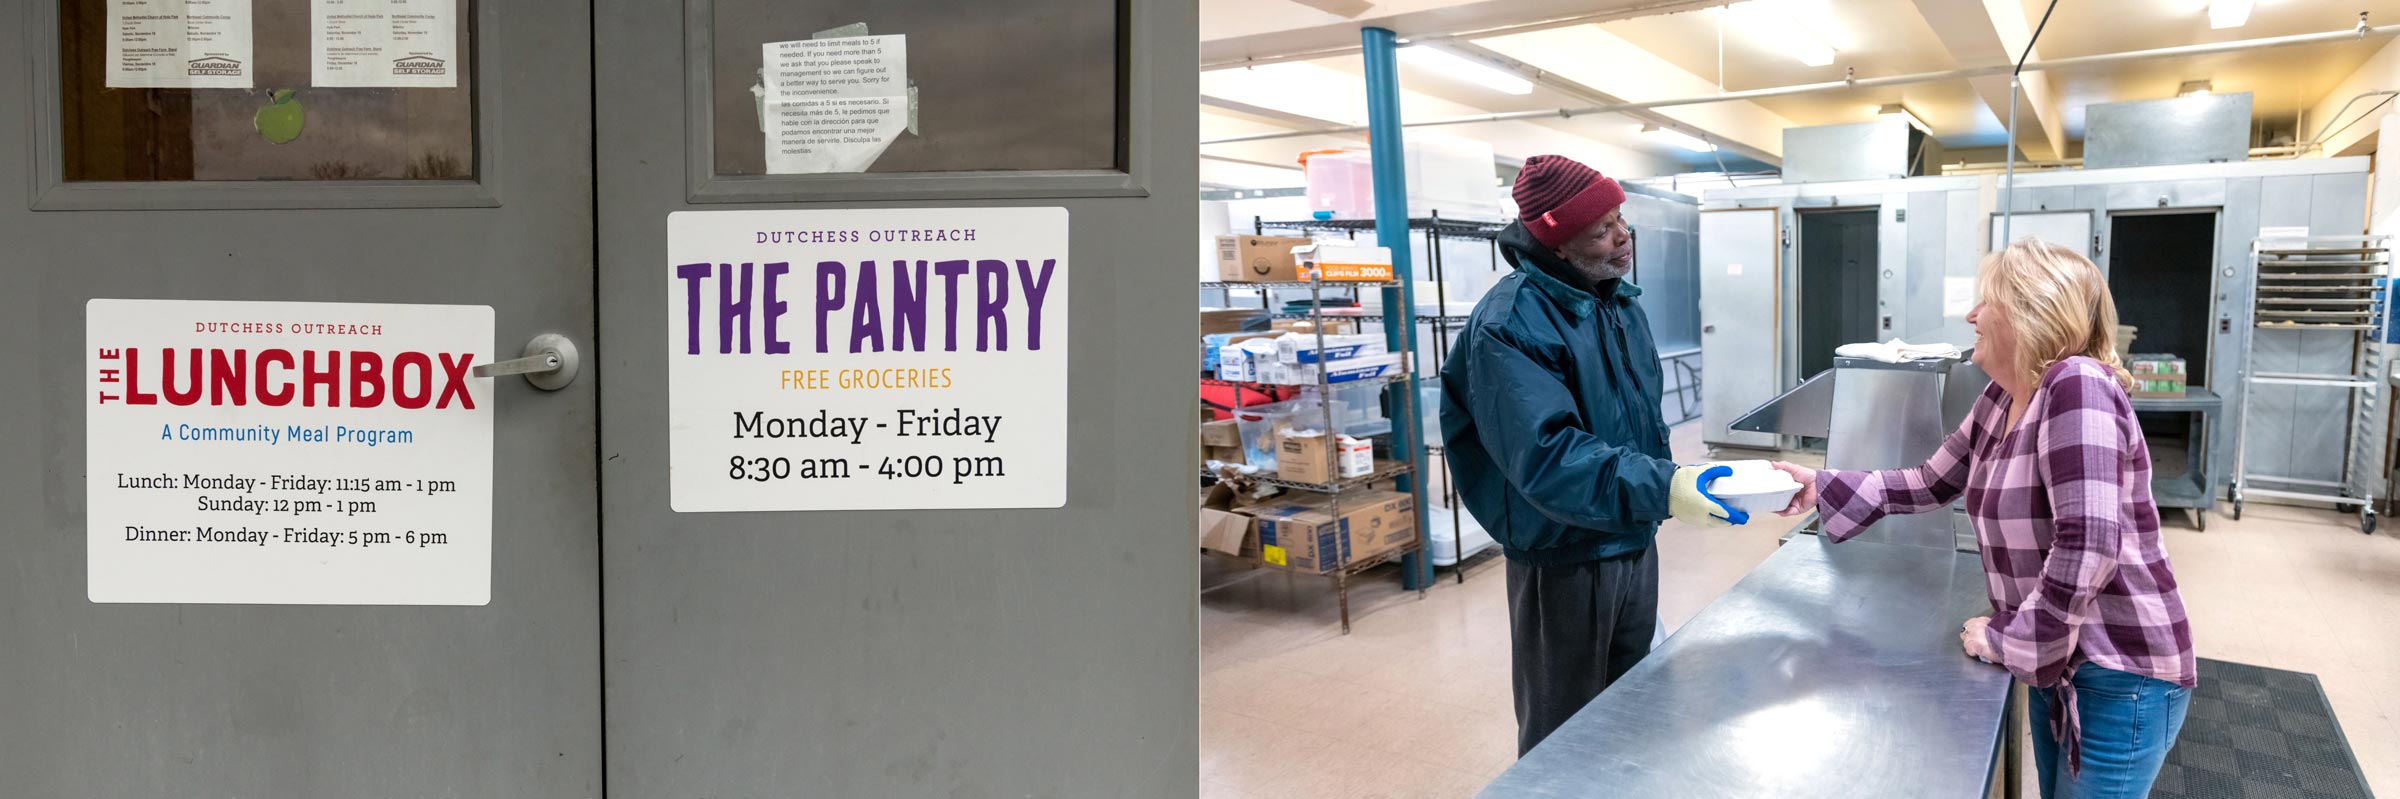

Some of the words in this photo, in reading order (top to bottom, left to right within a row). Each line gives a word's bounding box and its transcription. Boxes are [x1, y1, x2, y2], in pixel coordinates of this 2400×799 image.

[757, 231, 859, 244] DUTCHESS
[869, 229, 977, 242] OUTREACH
[1360, 266, 1386, 278] 3000
[676, 262, 791, 356] THE
[815, 258, 1057, 353] PANTRY
[195, 322, 283, 334] DUTCHESS
[291, 323, 382, 336] OUTREACH
[99, 347, 121, 405] THE
[125, 347, 477, 411] LUNCHBOX
[781, 370, 830, 390] FREE
[838, 368, 952, 389] GROCERIES
[1330, 367, 1379, 377] Aluminum
[1358, 371, 1376, 379] Foil
[161, 424, 173, 441] A
[179, 424, 281, 446] Community
[287, 425, 329, 443] Meal
[336, 426, 413, 447] Program
[733, 411, 868, 445] Monday
[896, 408, 1003, 444] Friday
[729, 456, 791, 483] 8:30
[800, 459, 851, 480] am
[877, 455, 944, 481] 4:00
[952, 456, 1006, 485] pm
[117, 472, 178, 489] Lunch:
[183, 474, 255, 494] Monday
[270, 475, 332, 495] Friday:
[336, 477, 371, 493] 11:15
[374, 479, 402, 492] am
[416, 479, 424, 492] 1
[427, 481, 457, 496] pm
[197, 496, 269, 516] Sunday:
[272, 499, 290, 512] 12
[293, 500, 323, 516] pm
[336, 499, 344, 513] 1
[347, 501, 377, 516] pm
[124, 526, 192, 542] Dinner:
[195, 527, 269, 547] Monday
[283, 528, 344, 548] Friday:
[347, 530, 358, 545] 5
[362, 532, 390, 548] pm
[406, 530, 416, 545] 6
[419, 532, 448, 548] pm
